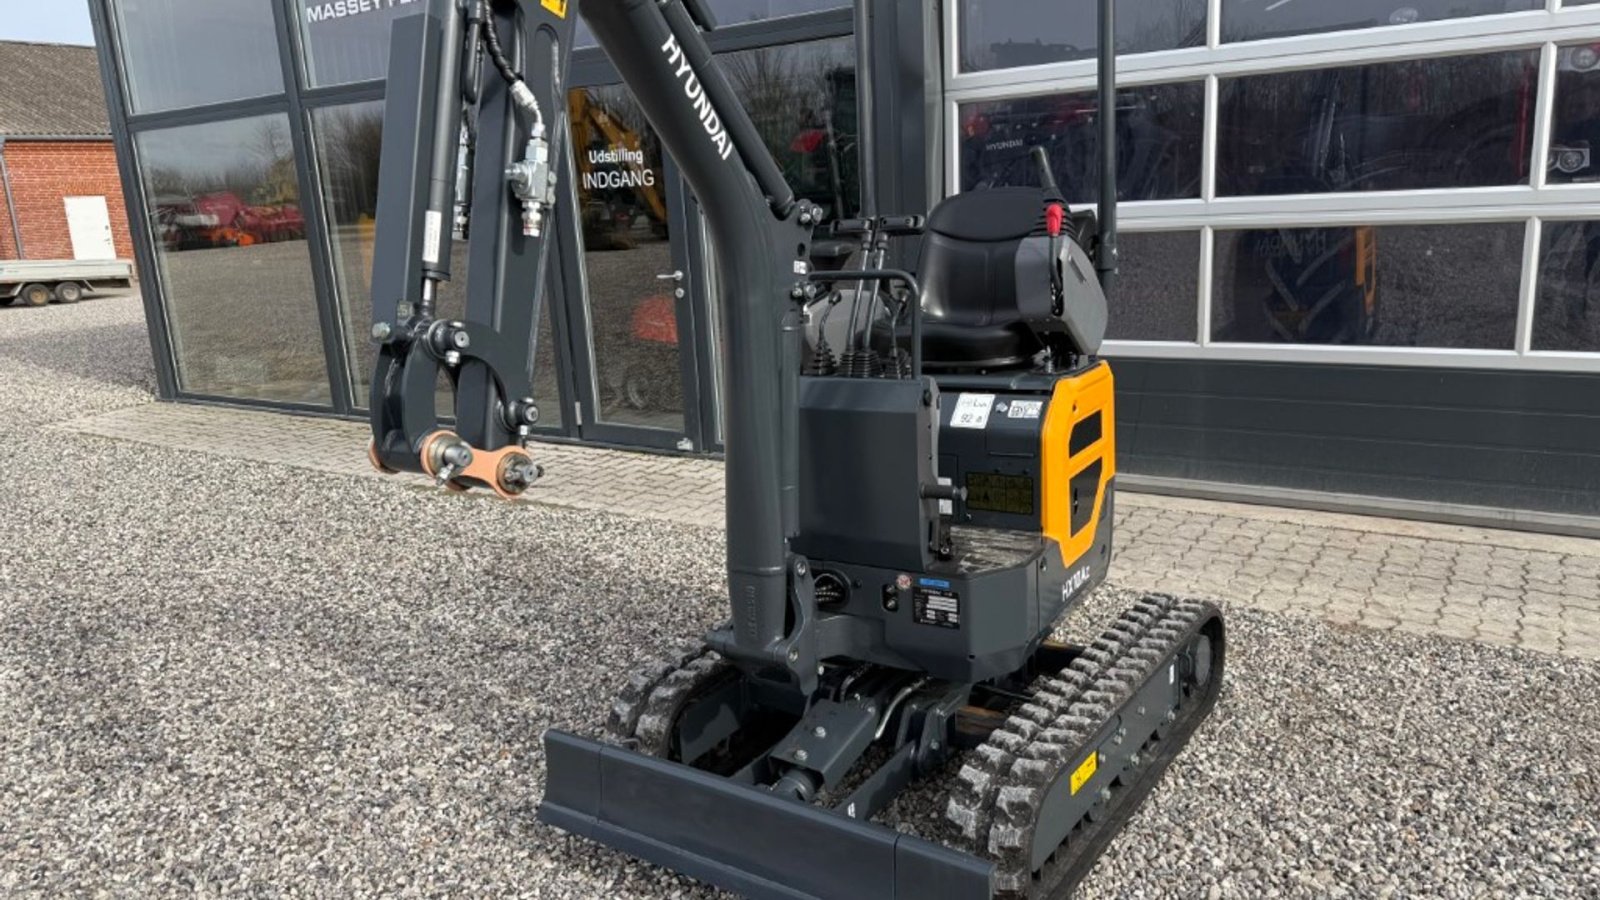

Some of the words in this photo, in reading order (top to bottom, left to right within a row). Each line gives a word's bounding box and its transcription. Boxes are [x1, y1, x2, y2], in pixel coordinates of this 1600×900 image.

[306, 0, 380, 23] MASSEY
[661, 33, 733, 161] HYUNDAI
[588, 148, 644, 164] Udstilling
[582, 168, 655, 189] INDGANG
